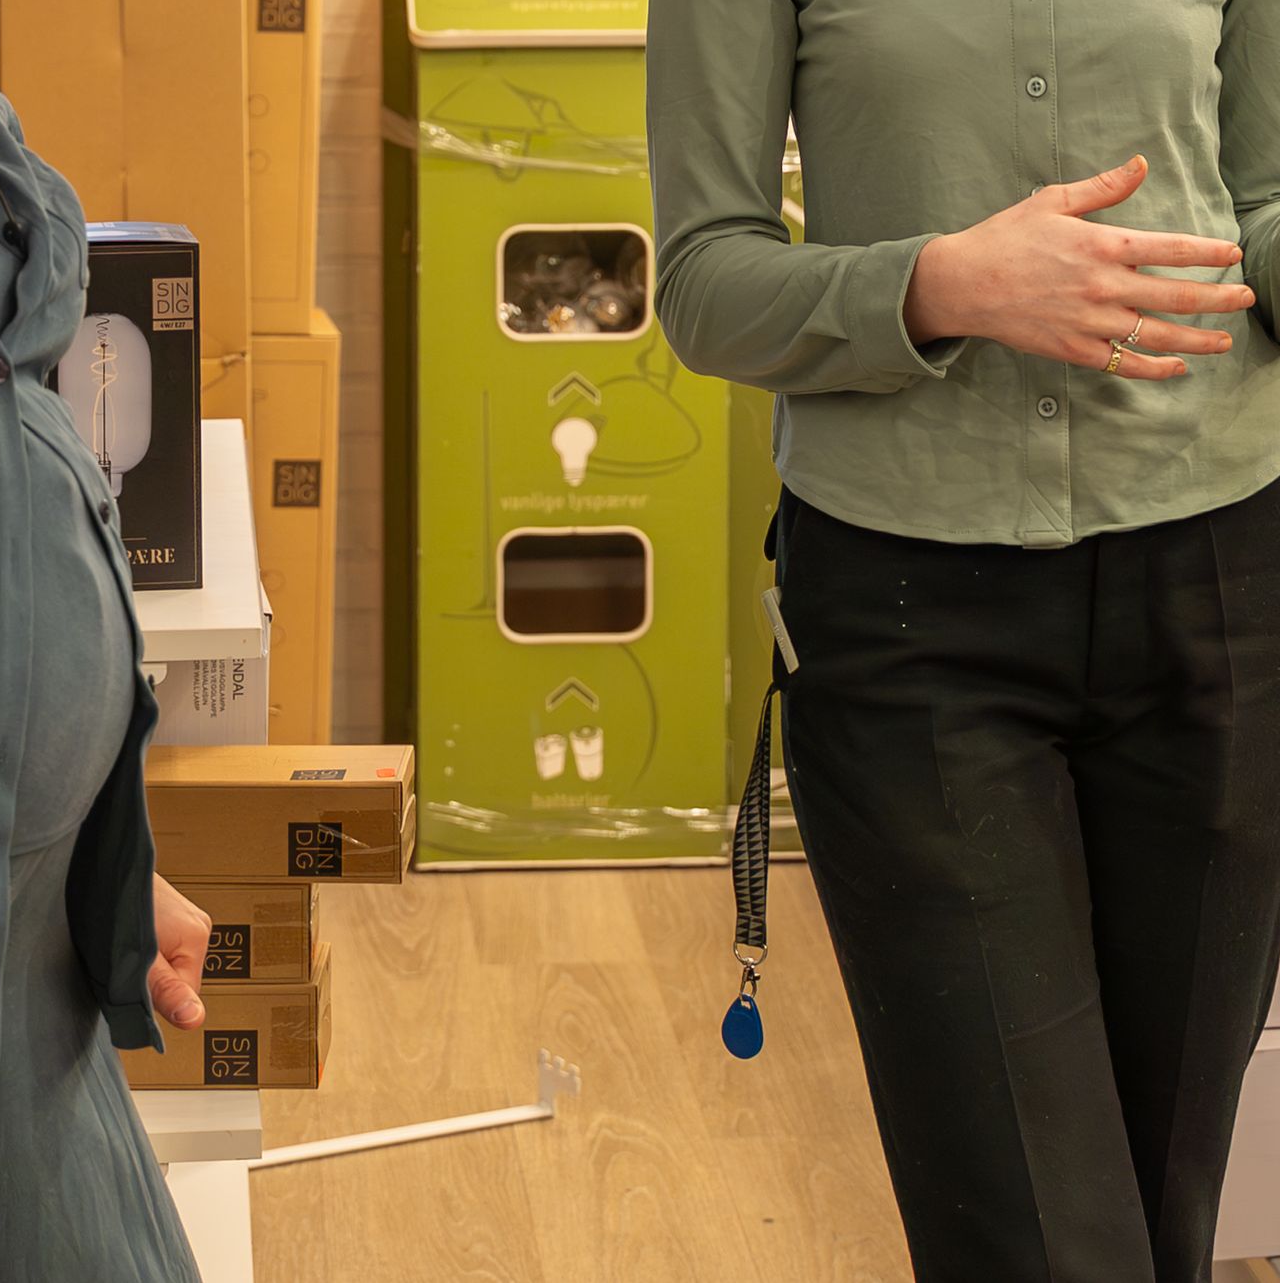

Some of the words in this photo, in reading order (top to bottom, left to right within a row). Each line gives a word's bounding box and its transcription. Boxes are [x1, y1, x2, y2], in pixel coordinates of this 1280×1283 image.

[156, 281, 189, 297] SIN
[156, 299, 190, 314] DIG
[295, 829, 314, 870] DIG
[317, 828, 334, 869] SIN
[204, 931, 222, 972] DIG
[224, 931, 243, 970] SIN
[211, 1037, 230, 1078] DIG
[232, 1037, 250, 1077] SIN
